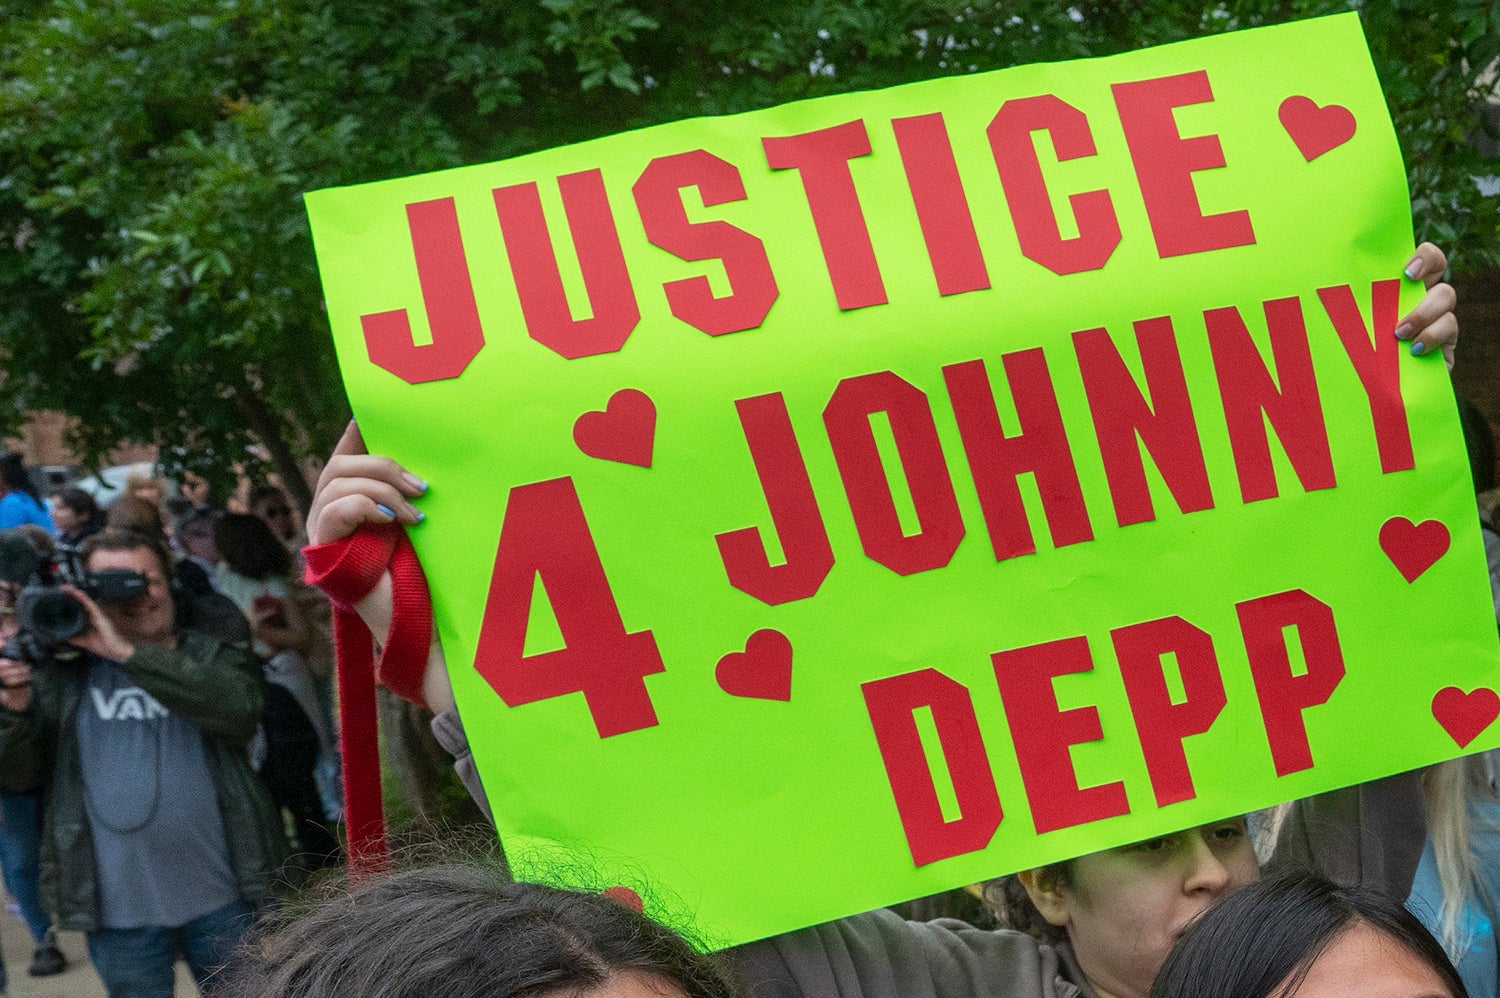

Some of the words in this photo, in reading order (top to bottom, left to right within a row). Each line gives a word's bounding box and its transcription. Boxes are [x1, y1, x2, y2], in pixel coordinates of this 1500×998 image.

[362, 71, 1254, 383] JUSTICE
[475, 478, 664, 737] 4
[716, 280, 1414, 604] JOHNNY
[90, 687, 169, 720] VAN
[862, 590, 1344, 866] DEPP
